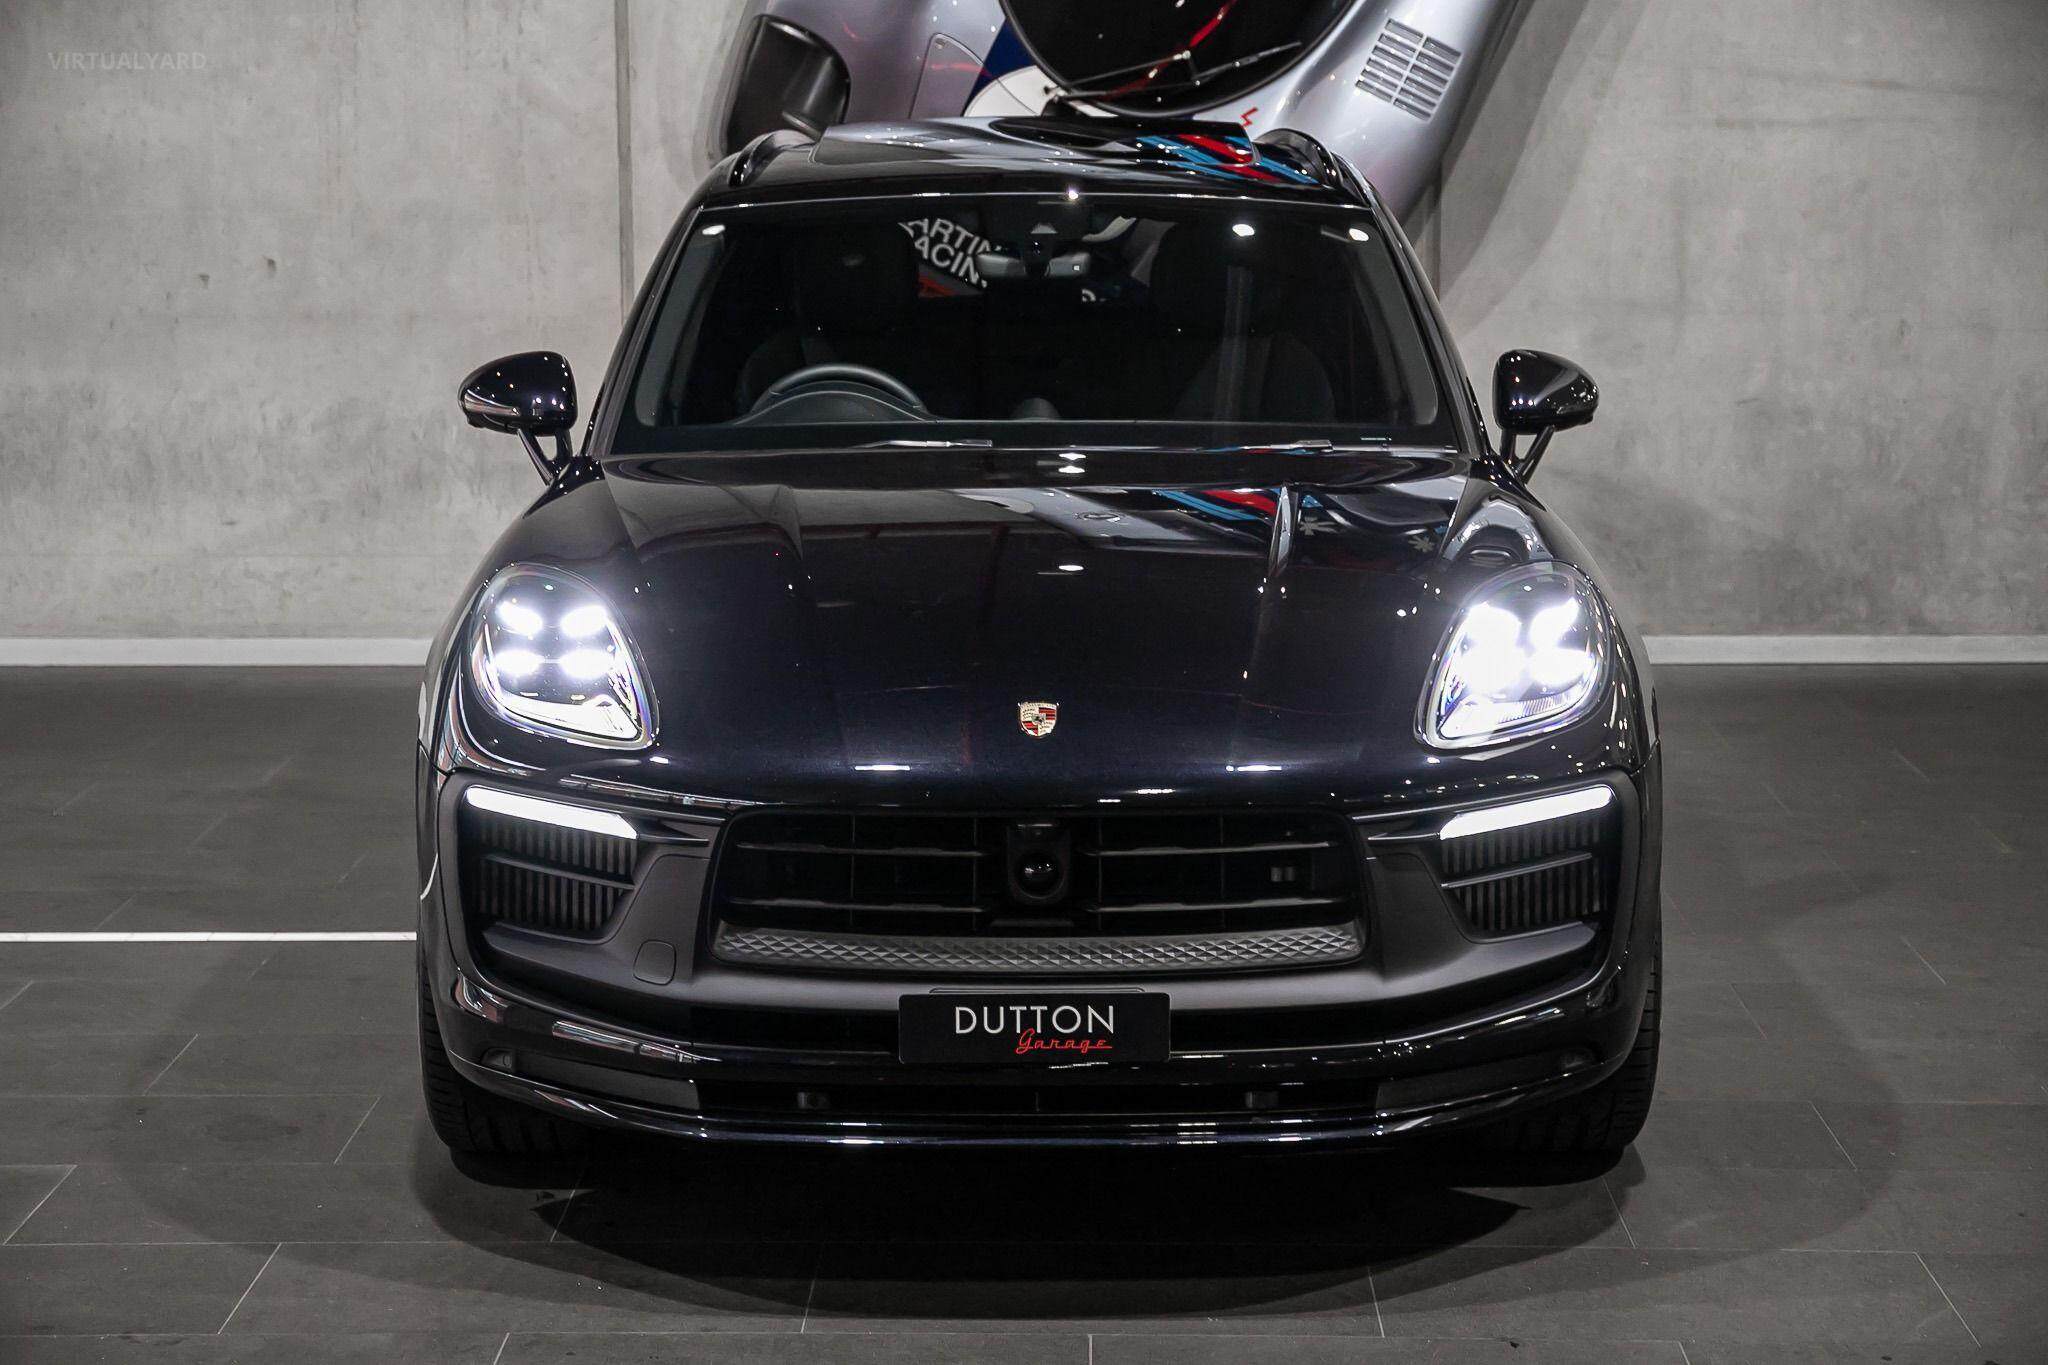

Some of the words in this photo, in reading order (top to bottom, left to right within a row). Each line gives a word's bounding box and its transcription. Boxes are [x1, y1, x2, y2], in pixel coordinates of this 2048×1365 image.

[898, 218, 1002, 255] ARTI
[914, 235, 988, 288] ACIN
[955, 1005, 1114, 1034] DUTTON
[1015, 1028, 1113, 1054] Garage
